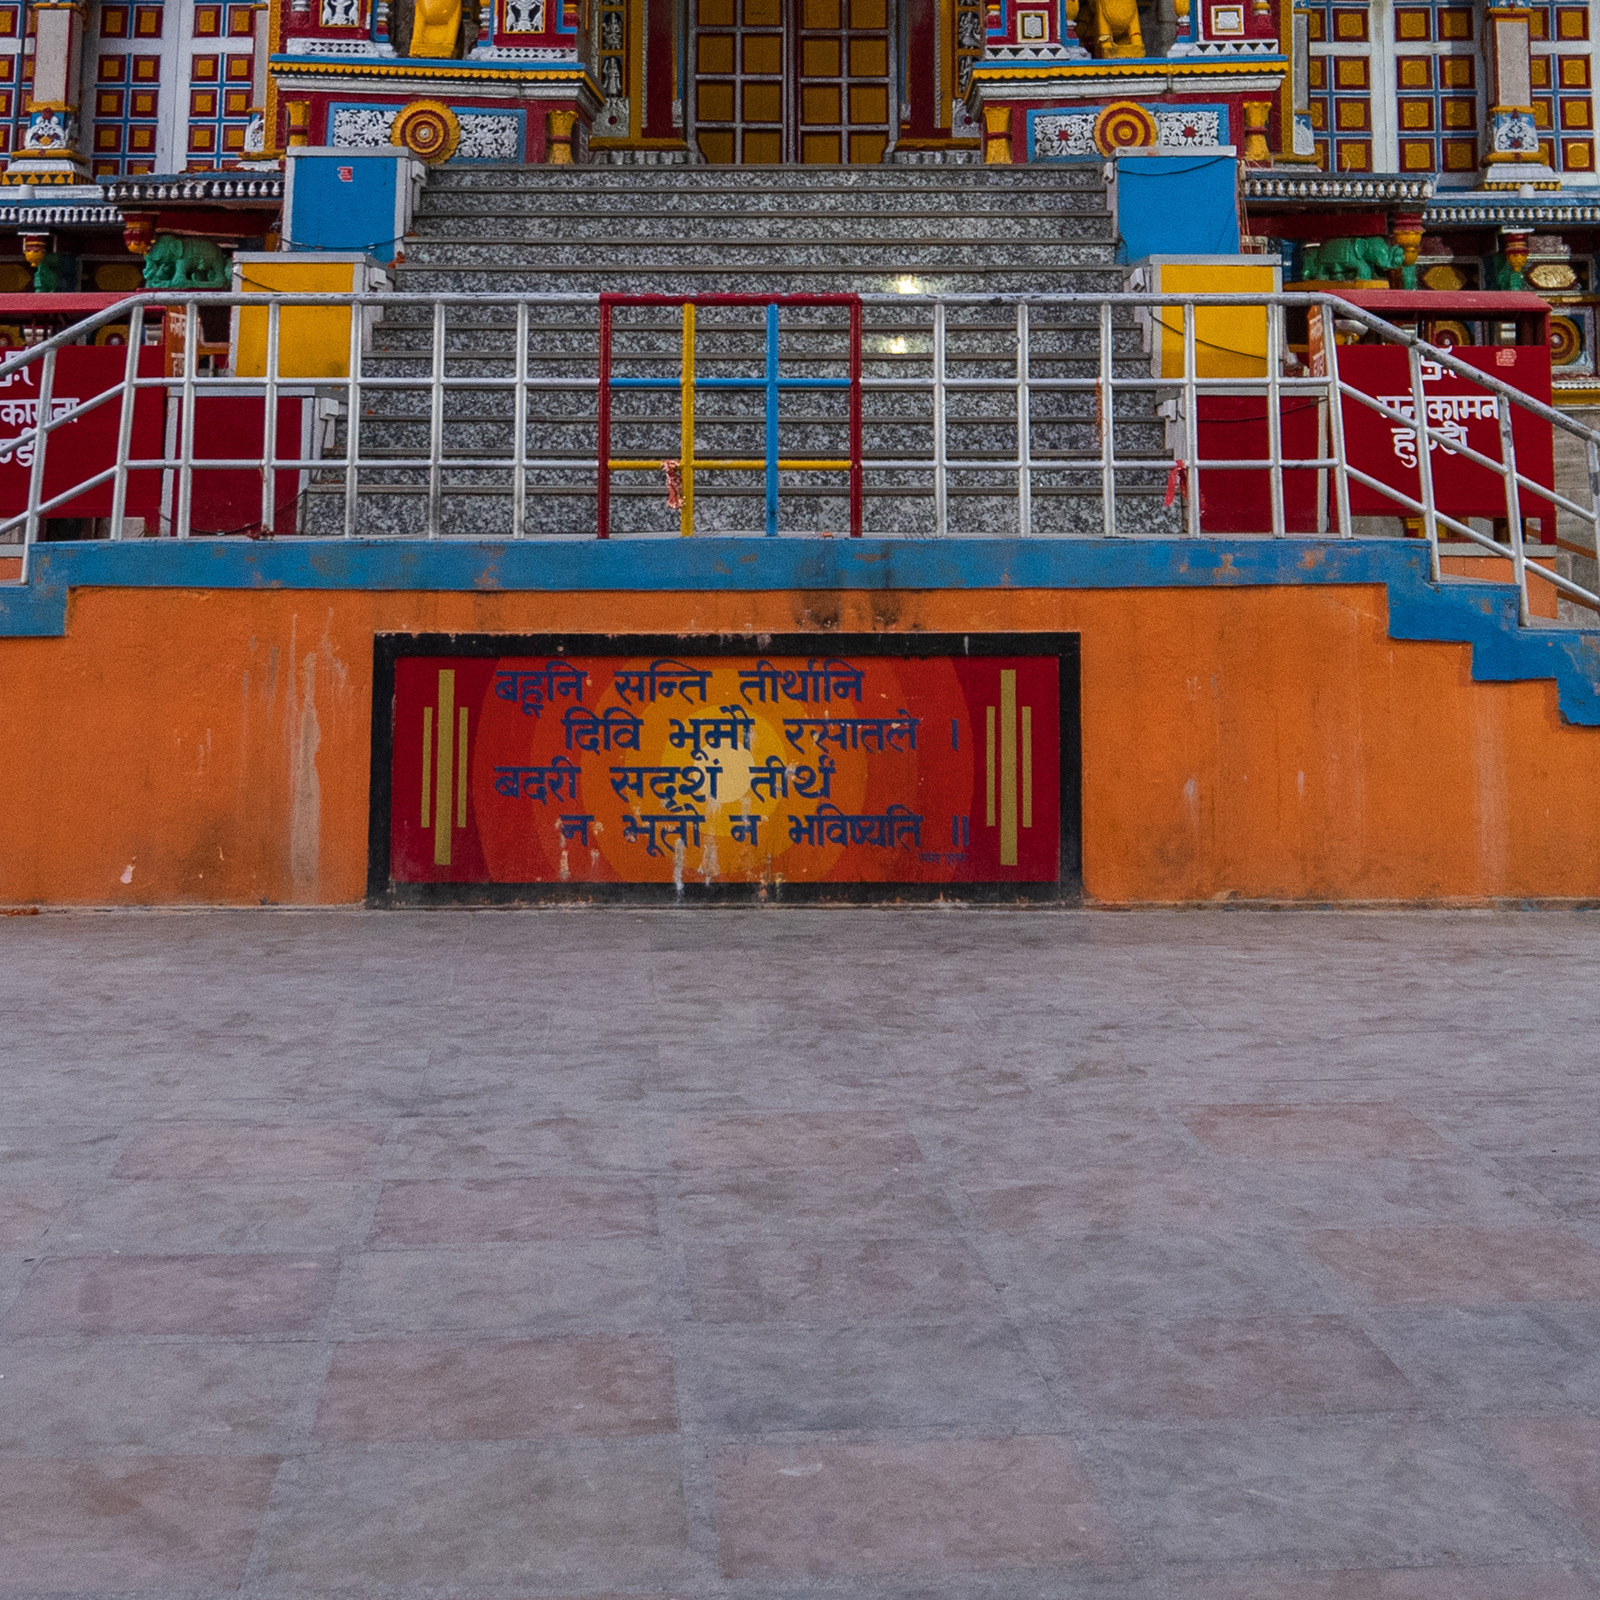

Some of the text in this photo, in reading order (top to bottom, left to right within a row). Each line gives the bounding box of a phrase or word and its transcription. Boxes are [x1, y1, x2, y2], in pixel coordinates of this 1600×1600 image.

[614, 659, 713, 705] सन्ति
[738, 658, 865, 704] तीर्थानि
[561, 706, 644, 755] दिवि
[669, 704, 755, 761] भूमौ
[783, 709, 920, 753] रसातले
[494, 754, 836, 812] बदरी सदृशं तीर्थं
[560, 814, 594, 847] न
[622, 803, 706, 857] भूतो
[729, 815, 761, 847] न
[787, 803, 924, 851] भविष्यति
